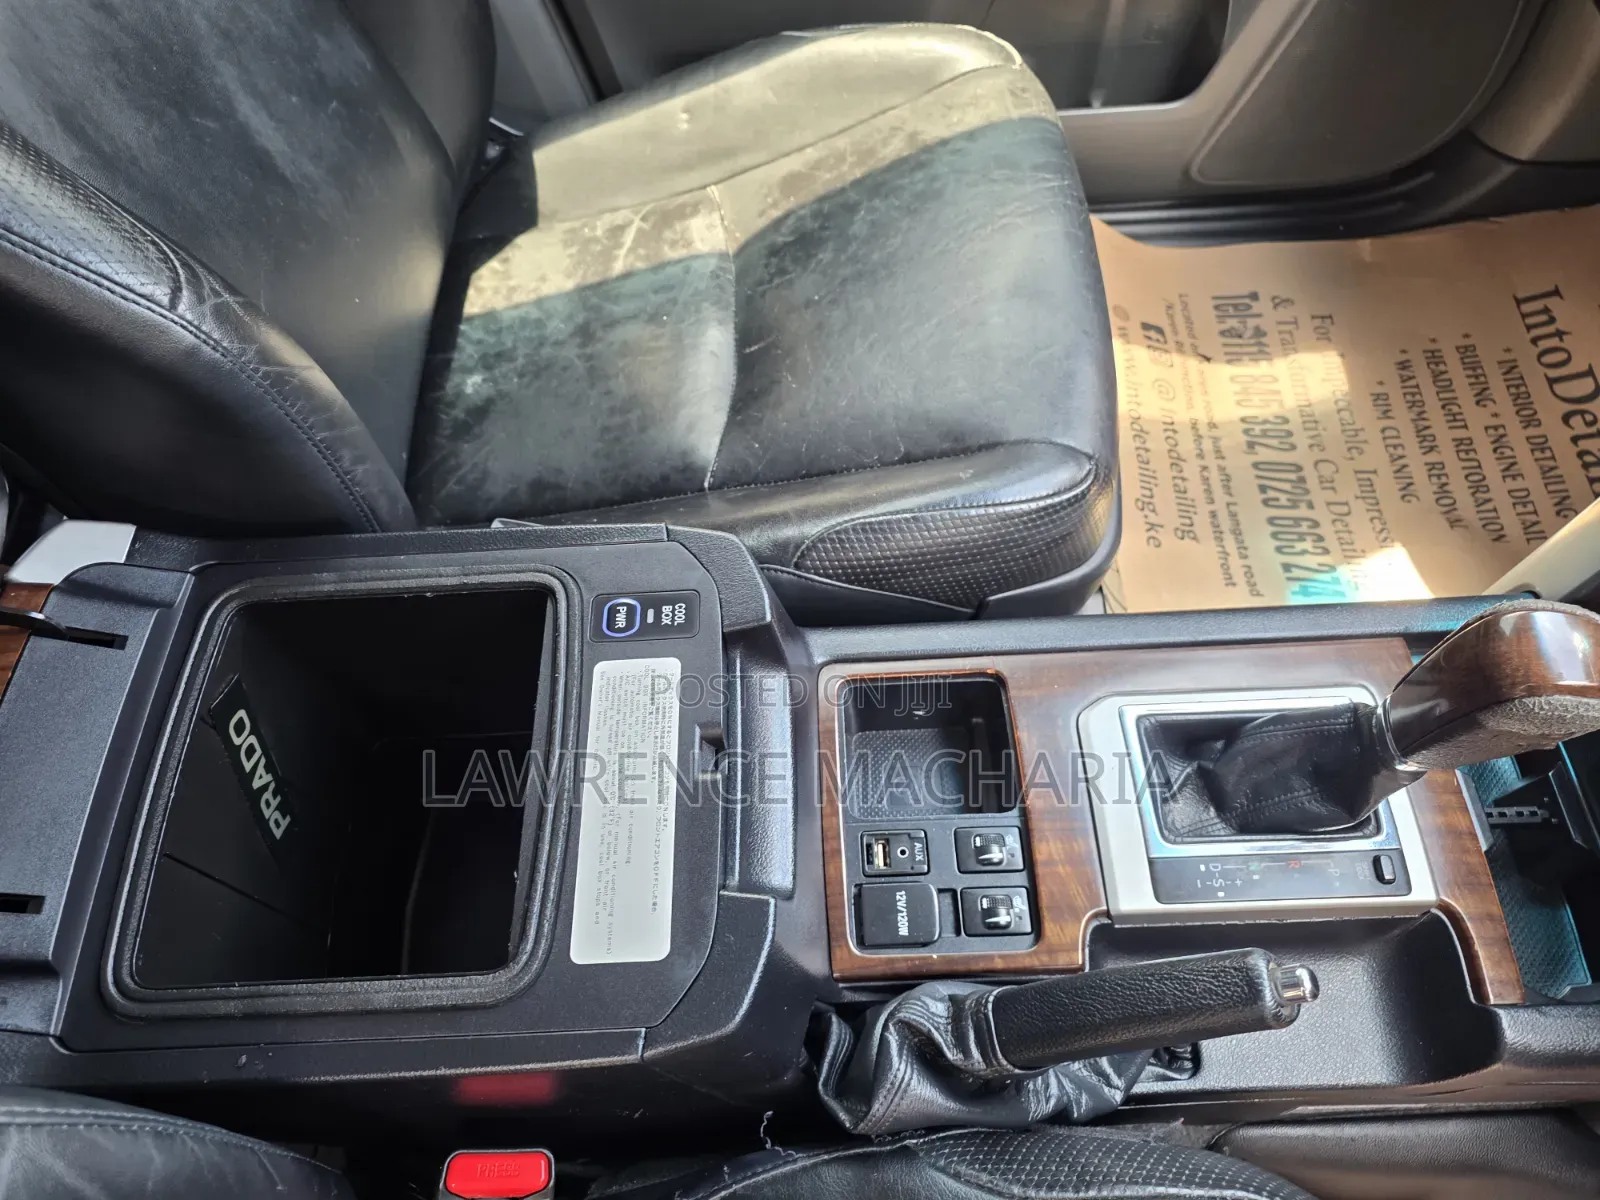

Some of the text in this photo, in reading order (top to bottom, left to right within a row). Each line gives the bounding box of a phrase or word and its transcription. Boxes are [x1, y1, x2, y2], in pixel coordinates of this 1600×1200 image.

[1178, 293, 1198, 340] Located
[1152, 379, 1176, 402] @
[1230, 375, 1284, 410] 845
[1271, 296, 1295, 310] &
[1313, 459, 1339, 494] Car
[1512, 284, 1600, 499] IntoDeta
[1310, 314, 1334, 342] For
[1354, 468, 1396, 552] Impressi
[1455, 344, 1497, 408] BUFFING
[1484, 424, 1524, 482] ENGINE
[1208, 436, 1226, 460] just
[1370, 392, 1420, 503] RIM CLEANING
[1394, 359, 1470, 531] WATERMARK REMOVAL
[1422, 348, 1510, 544] HEADLIGHT RESTORATION
[1496, 358, 1578, 520] INTERIOR DETAILING
[1218, 464, 1234, 498] after
[1252, 462, 1314, 510] 0725
[1188, 418, 1206, 461] before
[1197, 464, 1216, 504] Karen
[1207, 510, 1238, 588] waterfront
[1225, 502, 1250, 560] Langata
[1266, 516, 1331, 556] 663
[1241, 564, 1264, 598] road
[1280, 563, 1347, 598] 274
[615, 606, 628, 628] PWR
[662, 606, 673, 626] BOX
[674, 603, 686, 626] COOL
[229, 709, 291, 840] PRADO
[914, 842, 924, 861] AUX
[1210, 863, 1221, 872] D
[1288, 860, 1300, 868] R
[1213, 879, 1224, 887] S
[1328, 868, 1340, 883] P
[896, 890, 909, 936] 12V/120W
